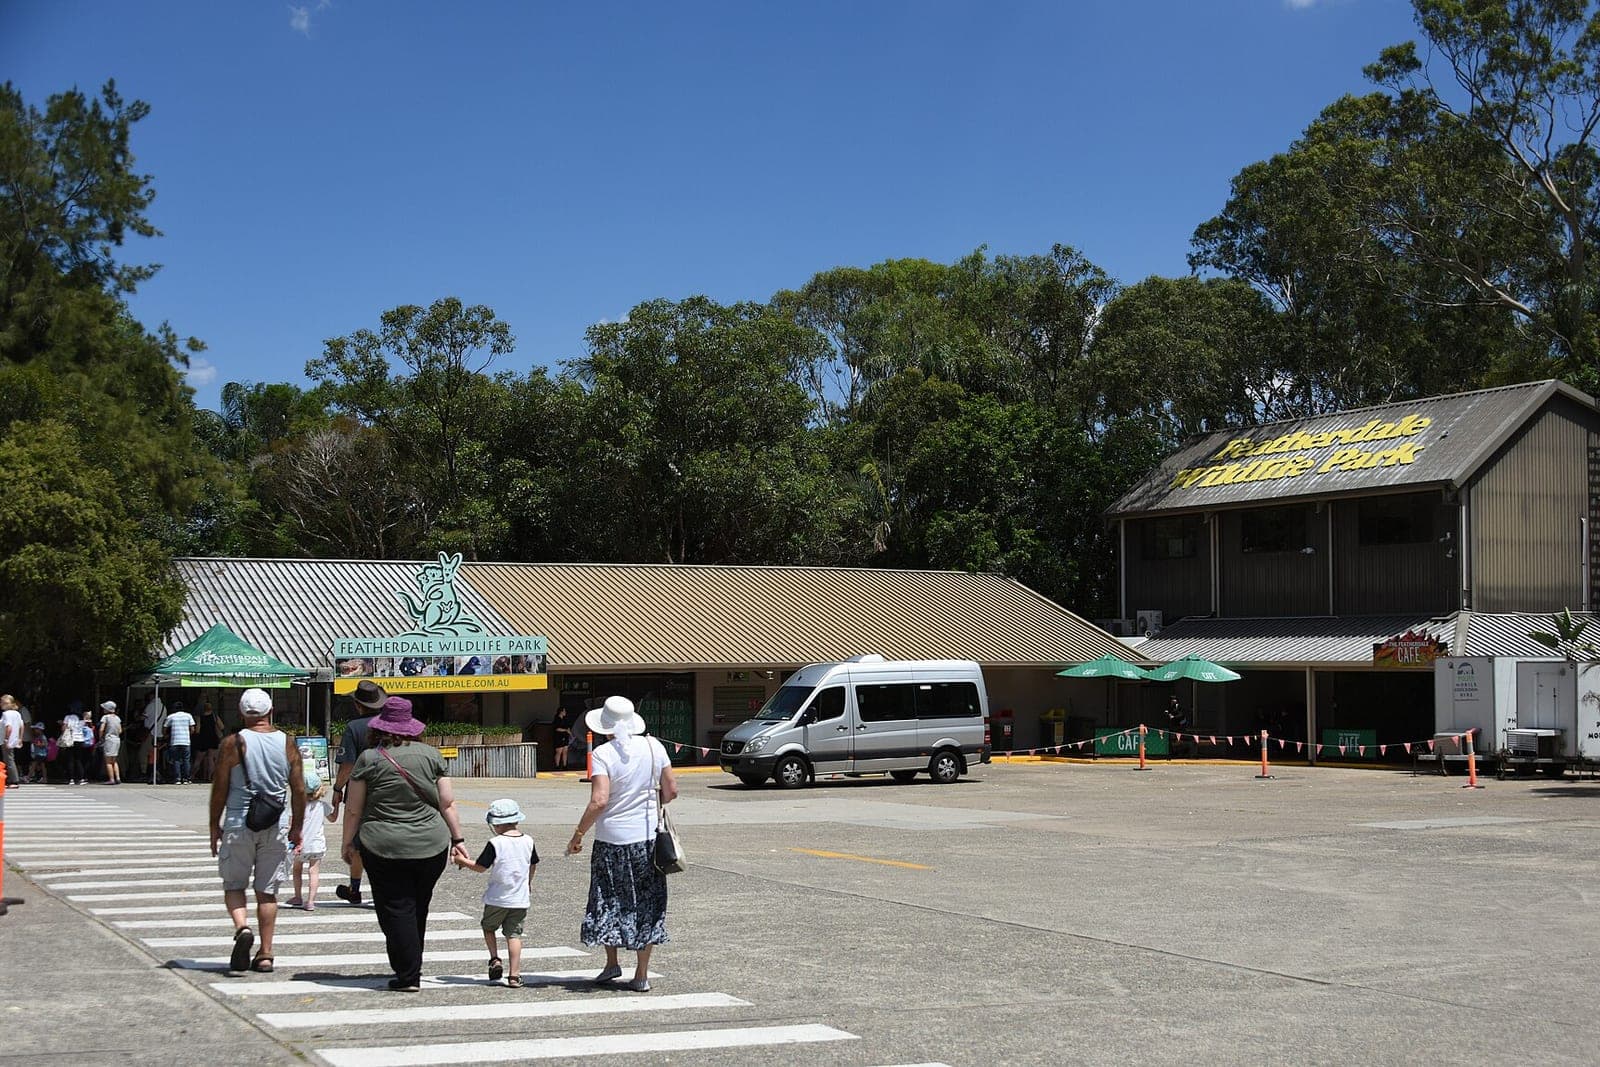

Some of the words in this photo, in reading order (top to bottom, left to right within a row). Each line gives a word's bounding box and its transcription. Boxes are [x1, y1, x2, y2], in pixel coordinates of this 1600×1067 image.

[1214, 414, 1431, 461] Featherdale
[1169, 455, 1314, 489] Wildlife
[1317, 442, 1425, 473] Park
[340, 640, 433, 654] FEATHERDALE
[439, 639, 502, 652] WILDLIFE
[509, 639, 541, 650] PARK
[1397, 646, 1420, 663] CAFE
[376, 679, 510, 689] WWW.FEATHERDALE.COM.AU
[1117, 734, 1147, 751] CAF
